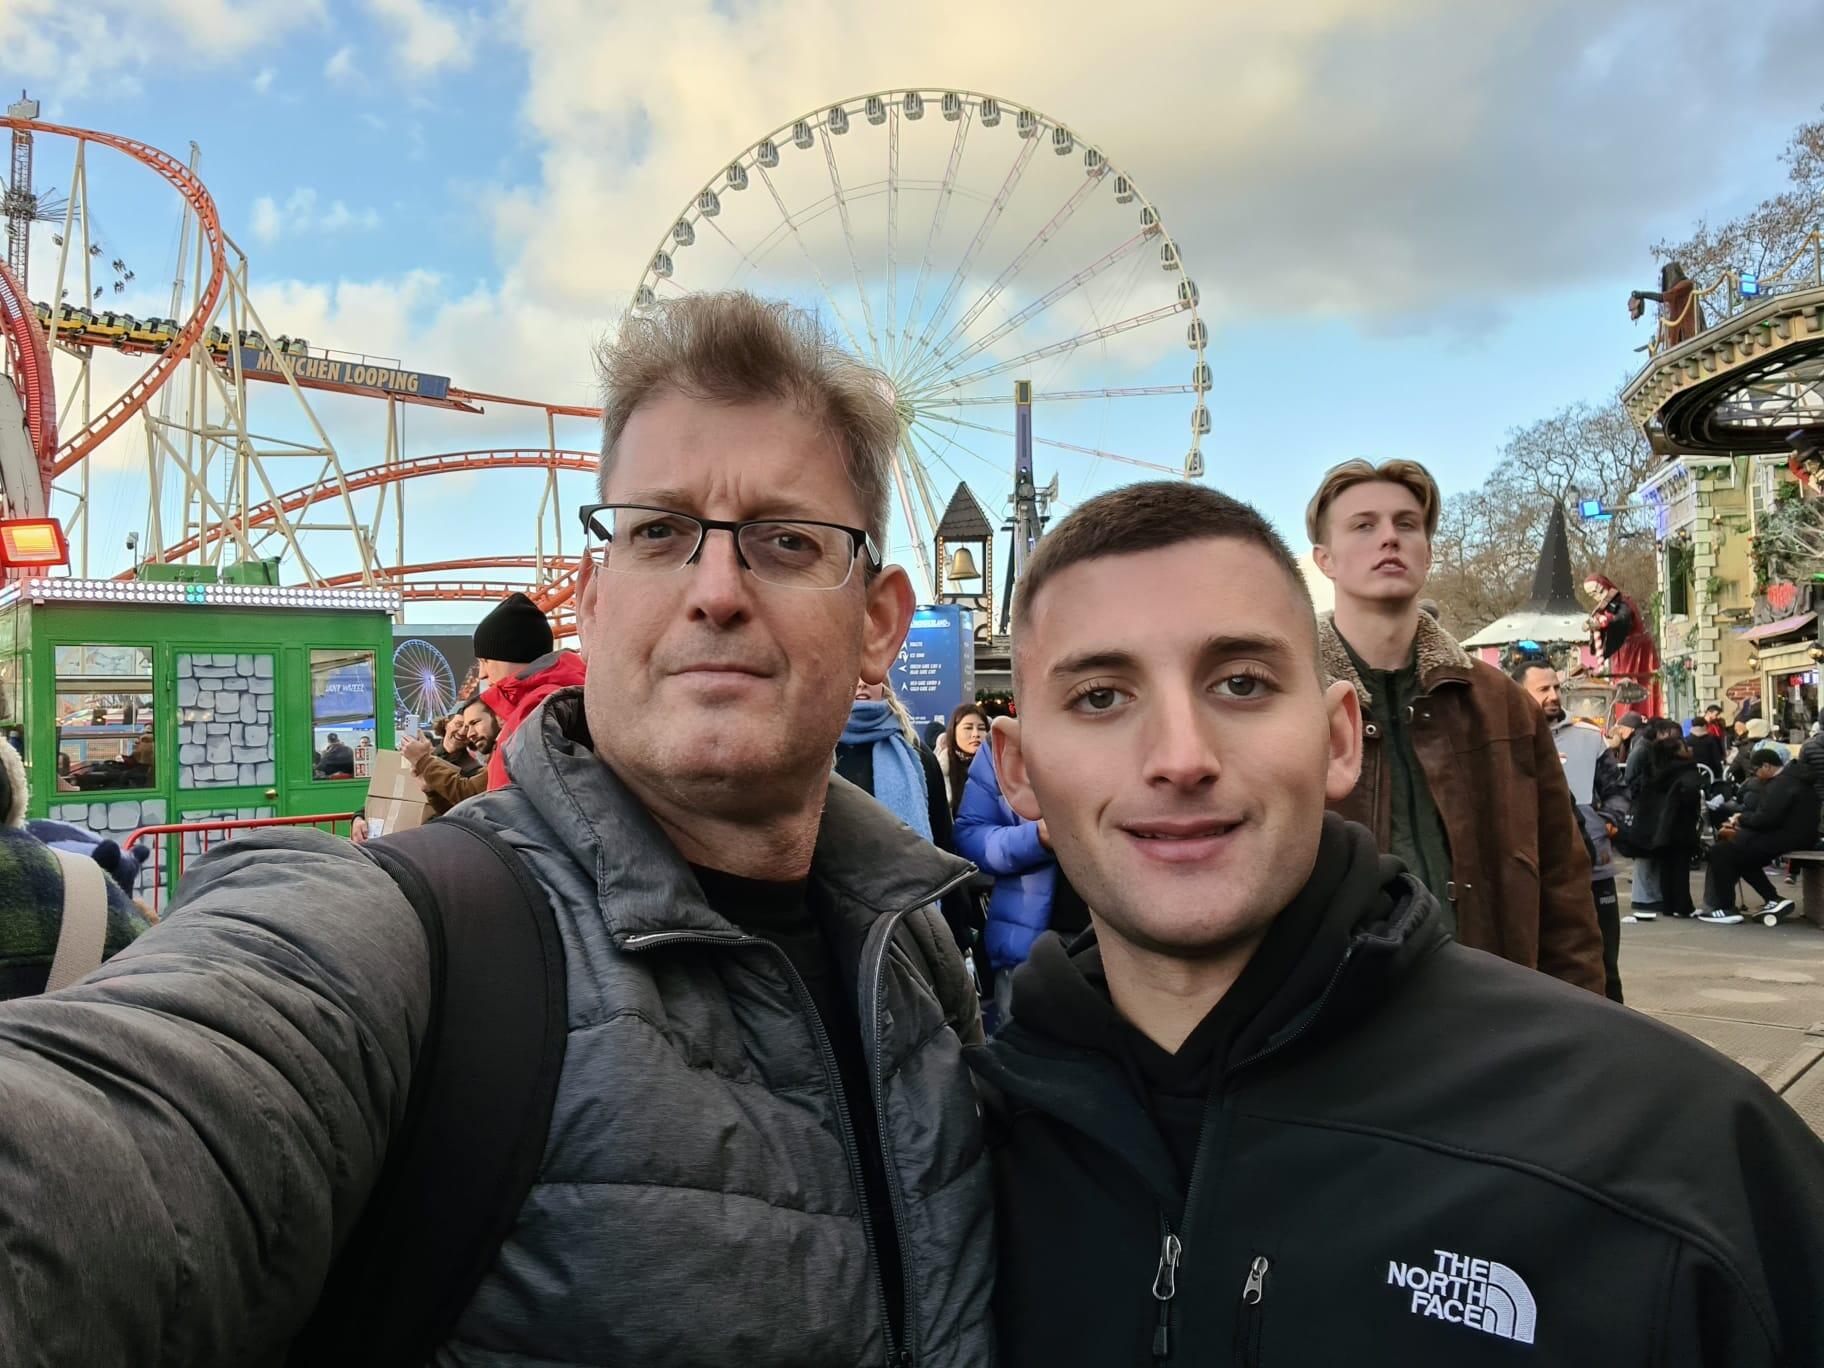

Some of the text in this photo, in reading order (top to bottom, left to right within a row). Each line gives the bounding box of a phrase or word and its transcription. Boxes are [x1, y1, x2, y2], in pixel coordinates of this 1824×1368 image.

[344, 361, 419, 392] LOOPING
[1387, 1261, 1487, 1308] NORTH
[1434, 1249, 1490, 1284] THE
[1411, 1290, 1484, 1330] FACE
